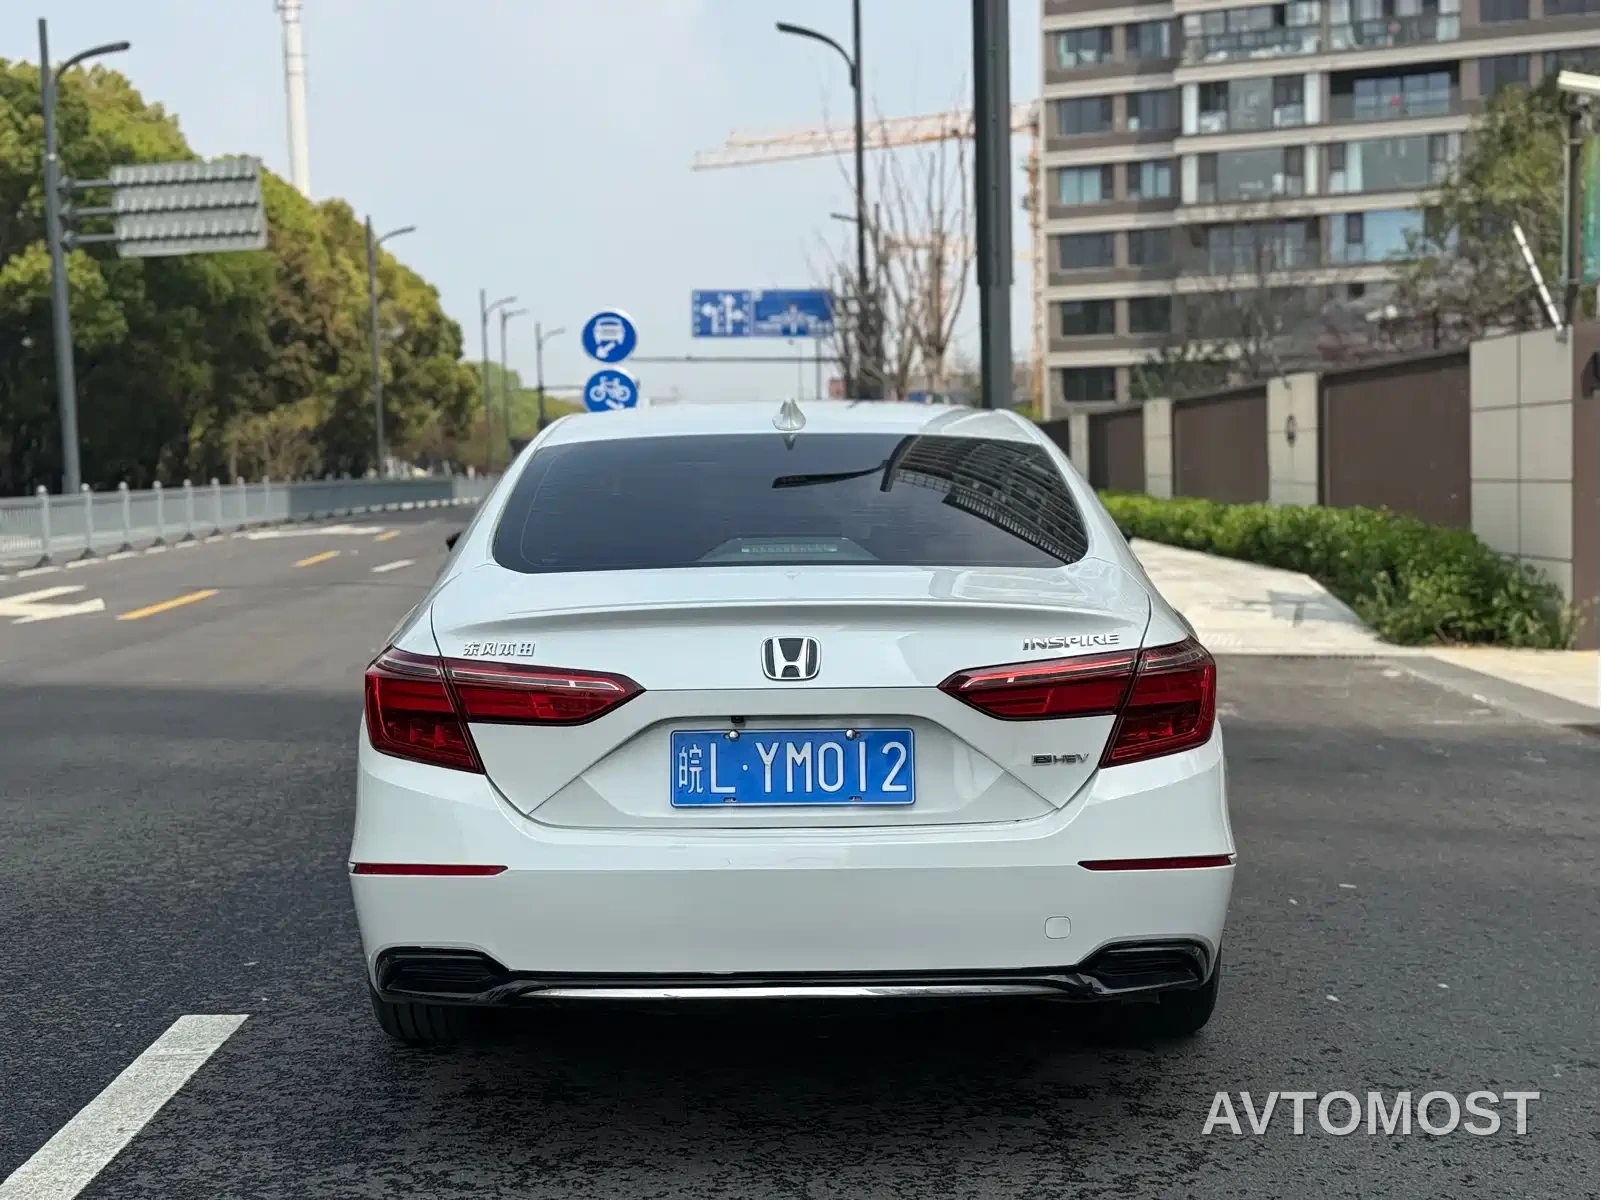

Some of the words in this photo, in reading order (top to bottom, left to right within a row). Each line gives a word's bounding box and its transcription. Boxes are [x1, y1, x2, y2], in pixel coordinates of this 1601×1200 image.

[463, 641, 535, 657] 东风本田
[1022, 633, 1120, 651] INSPIRE
